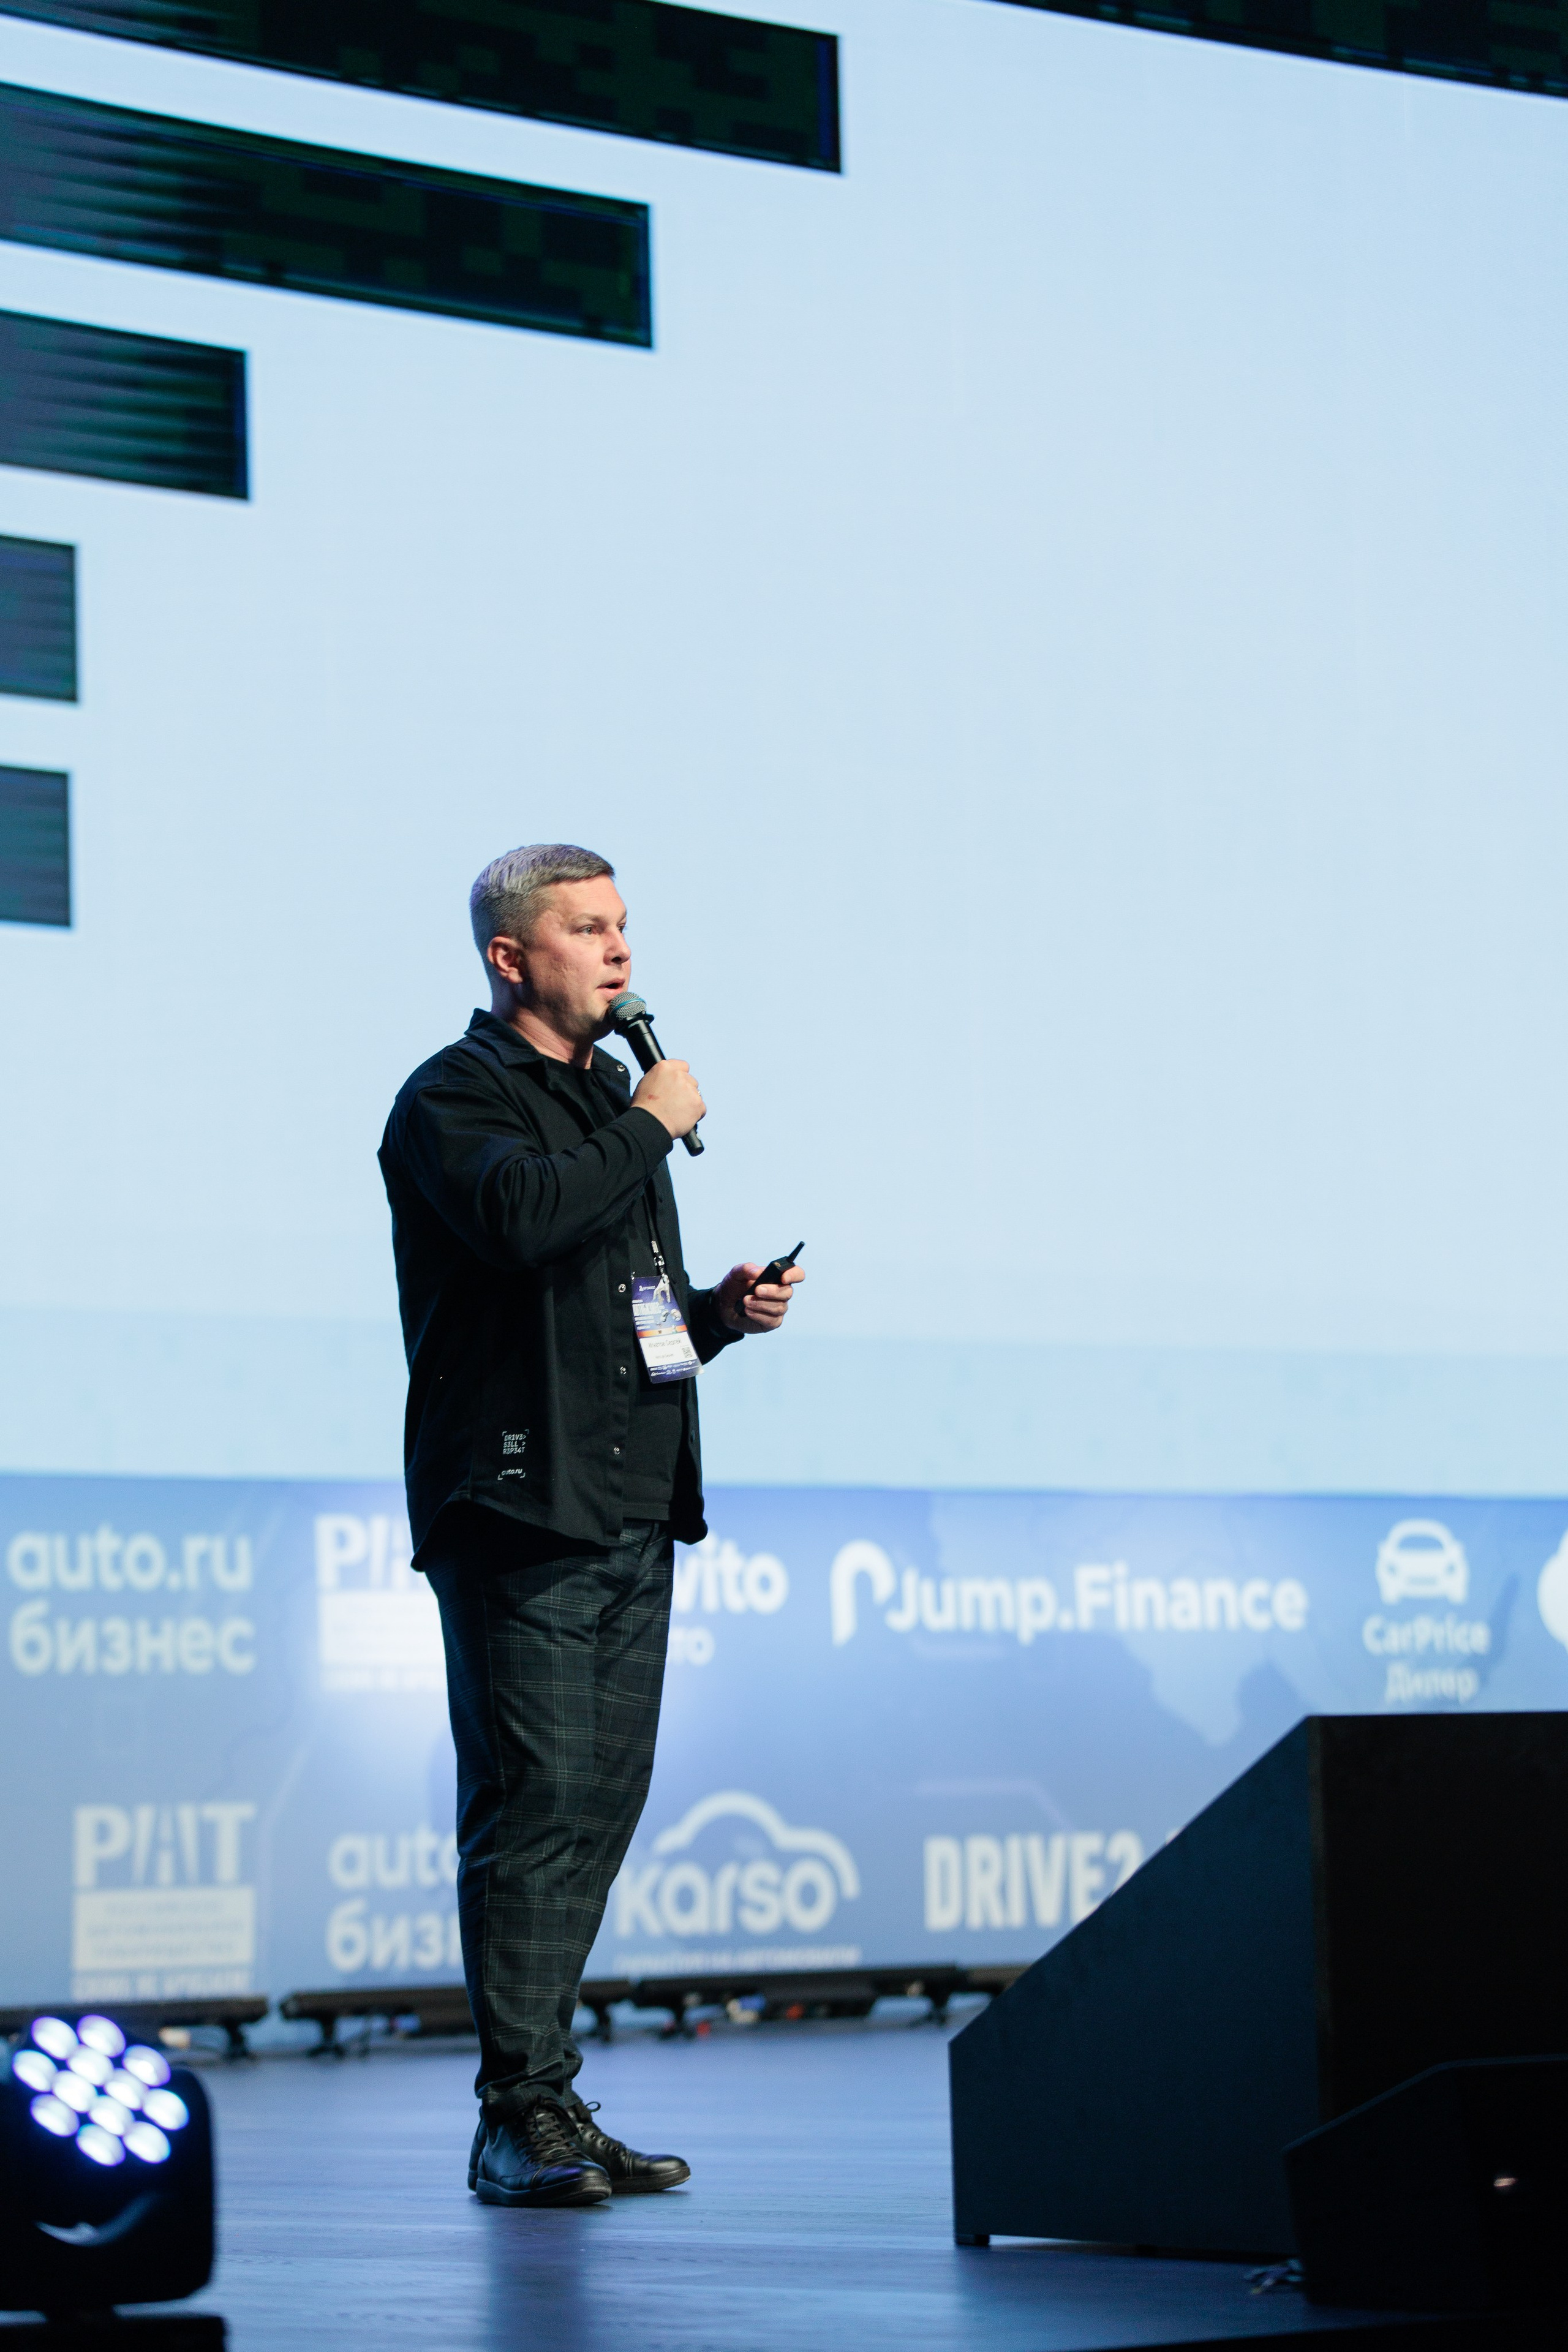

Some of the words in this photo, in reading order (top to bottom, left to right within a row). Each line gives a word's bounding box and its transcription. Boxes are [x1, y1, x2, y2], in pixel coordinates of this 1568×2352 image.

[7, 1524, 252, 1593] auto.ru
[673, 1531, 788, 1615] vito
[10, 1600, 255, 1676] бизнес
[887, 1562, 1307, 1644] Jump.Finance
[1363, 1615, 1491, 1655] CarPrice
